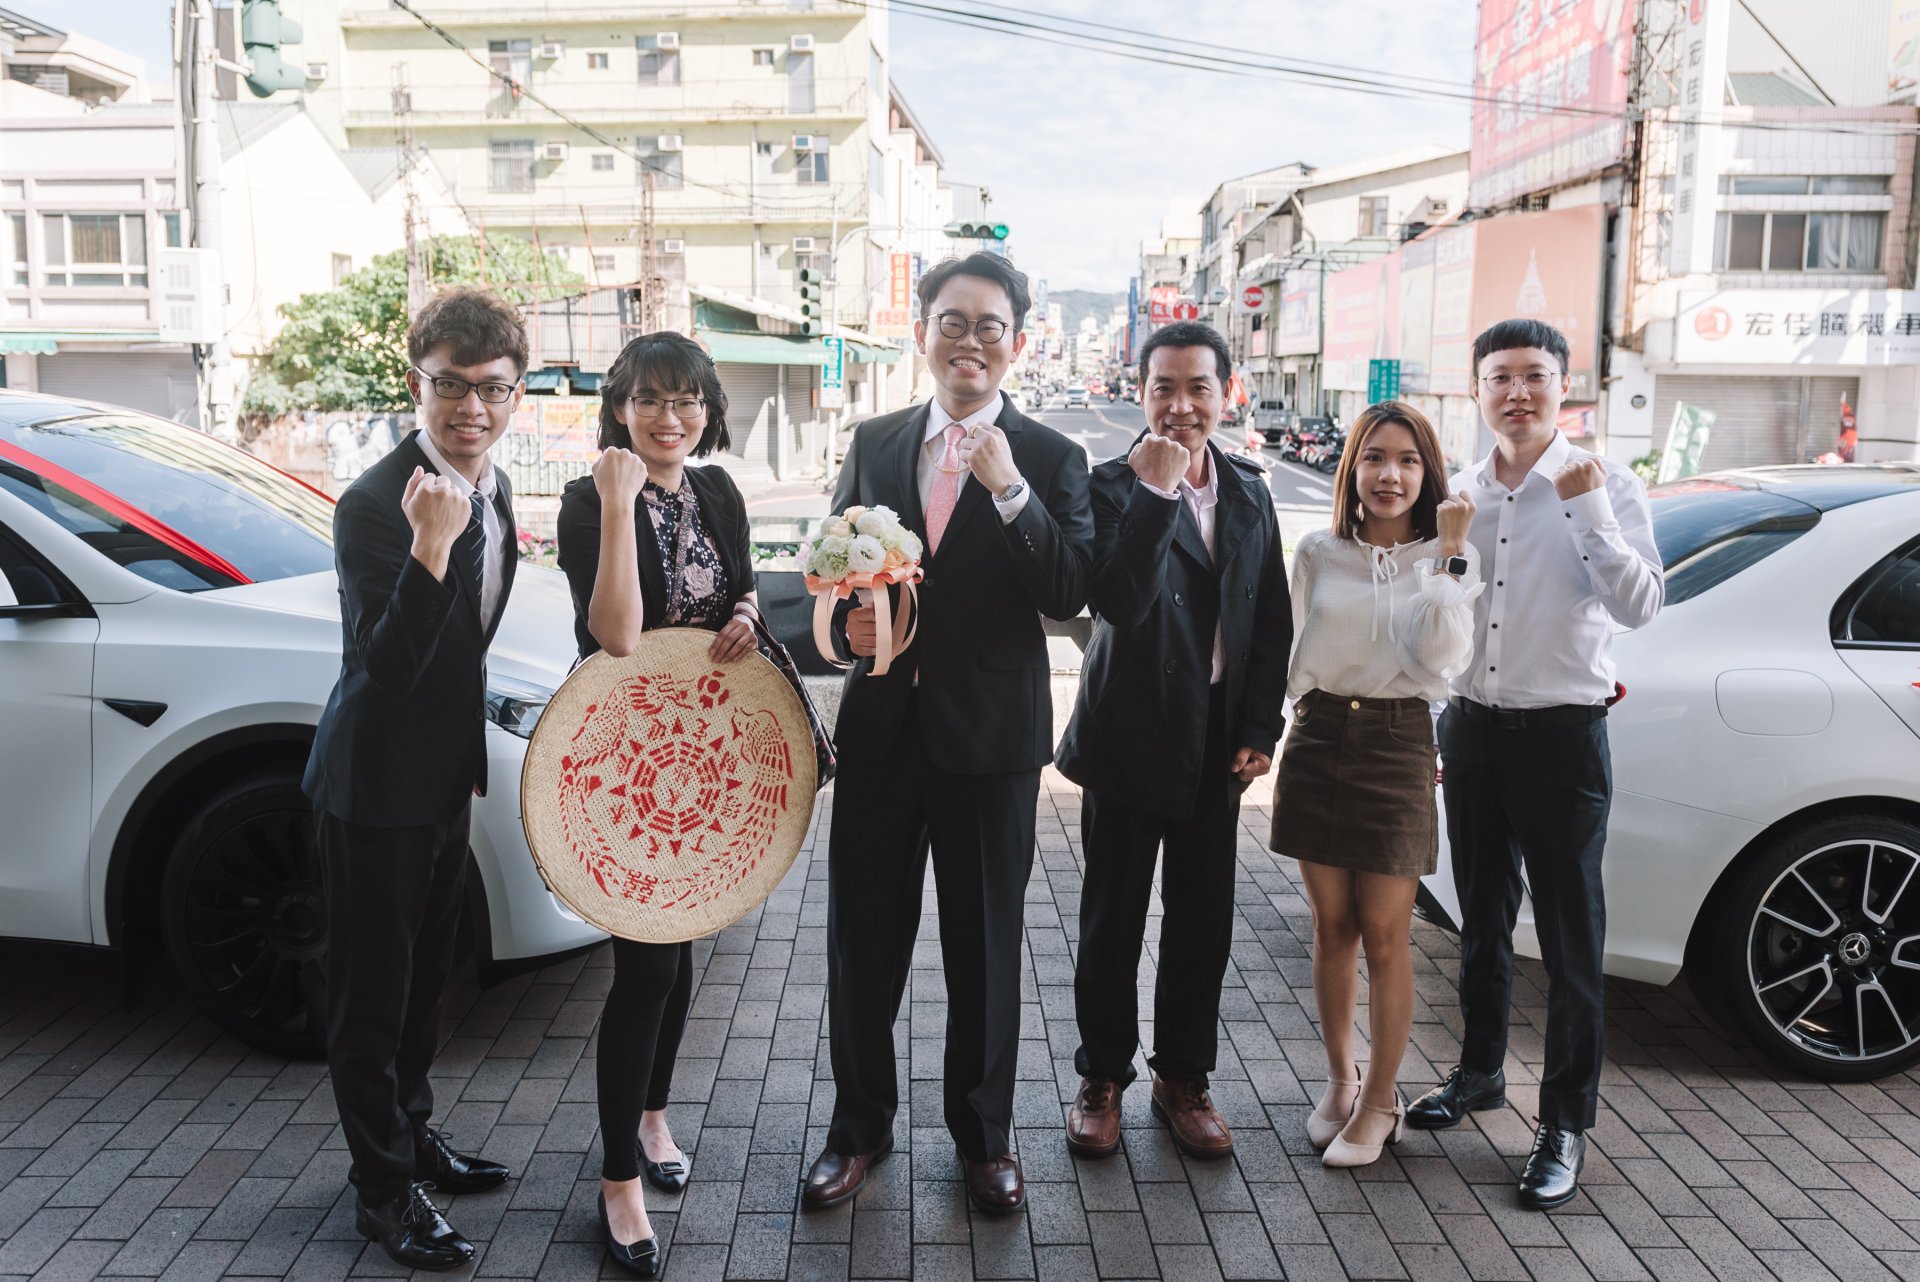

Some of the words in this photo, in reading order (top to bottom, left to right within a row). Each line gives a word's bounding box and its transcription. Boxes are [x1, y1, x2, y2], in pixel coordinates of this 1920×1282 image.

[1745, 312, 1920, 338] 宏佳騰機車
